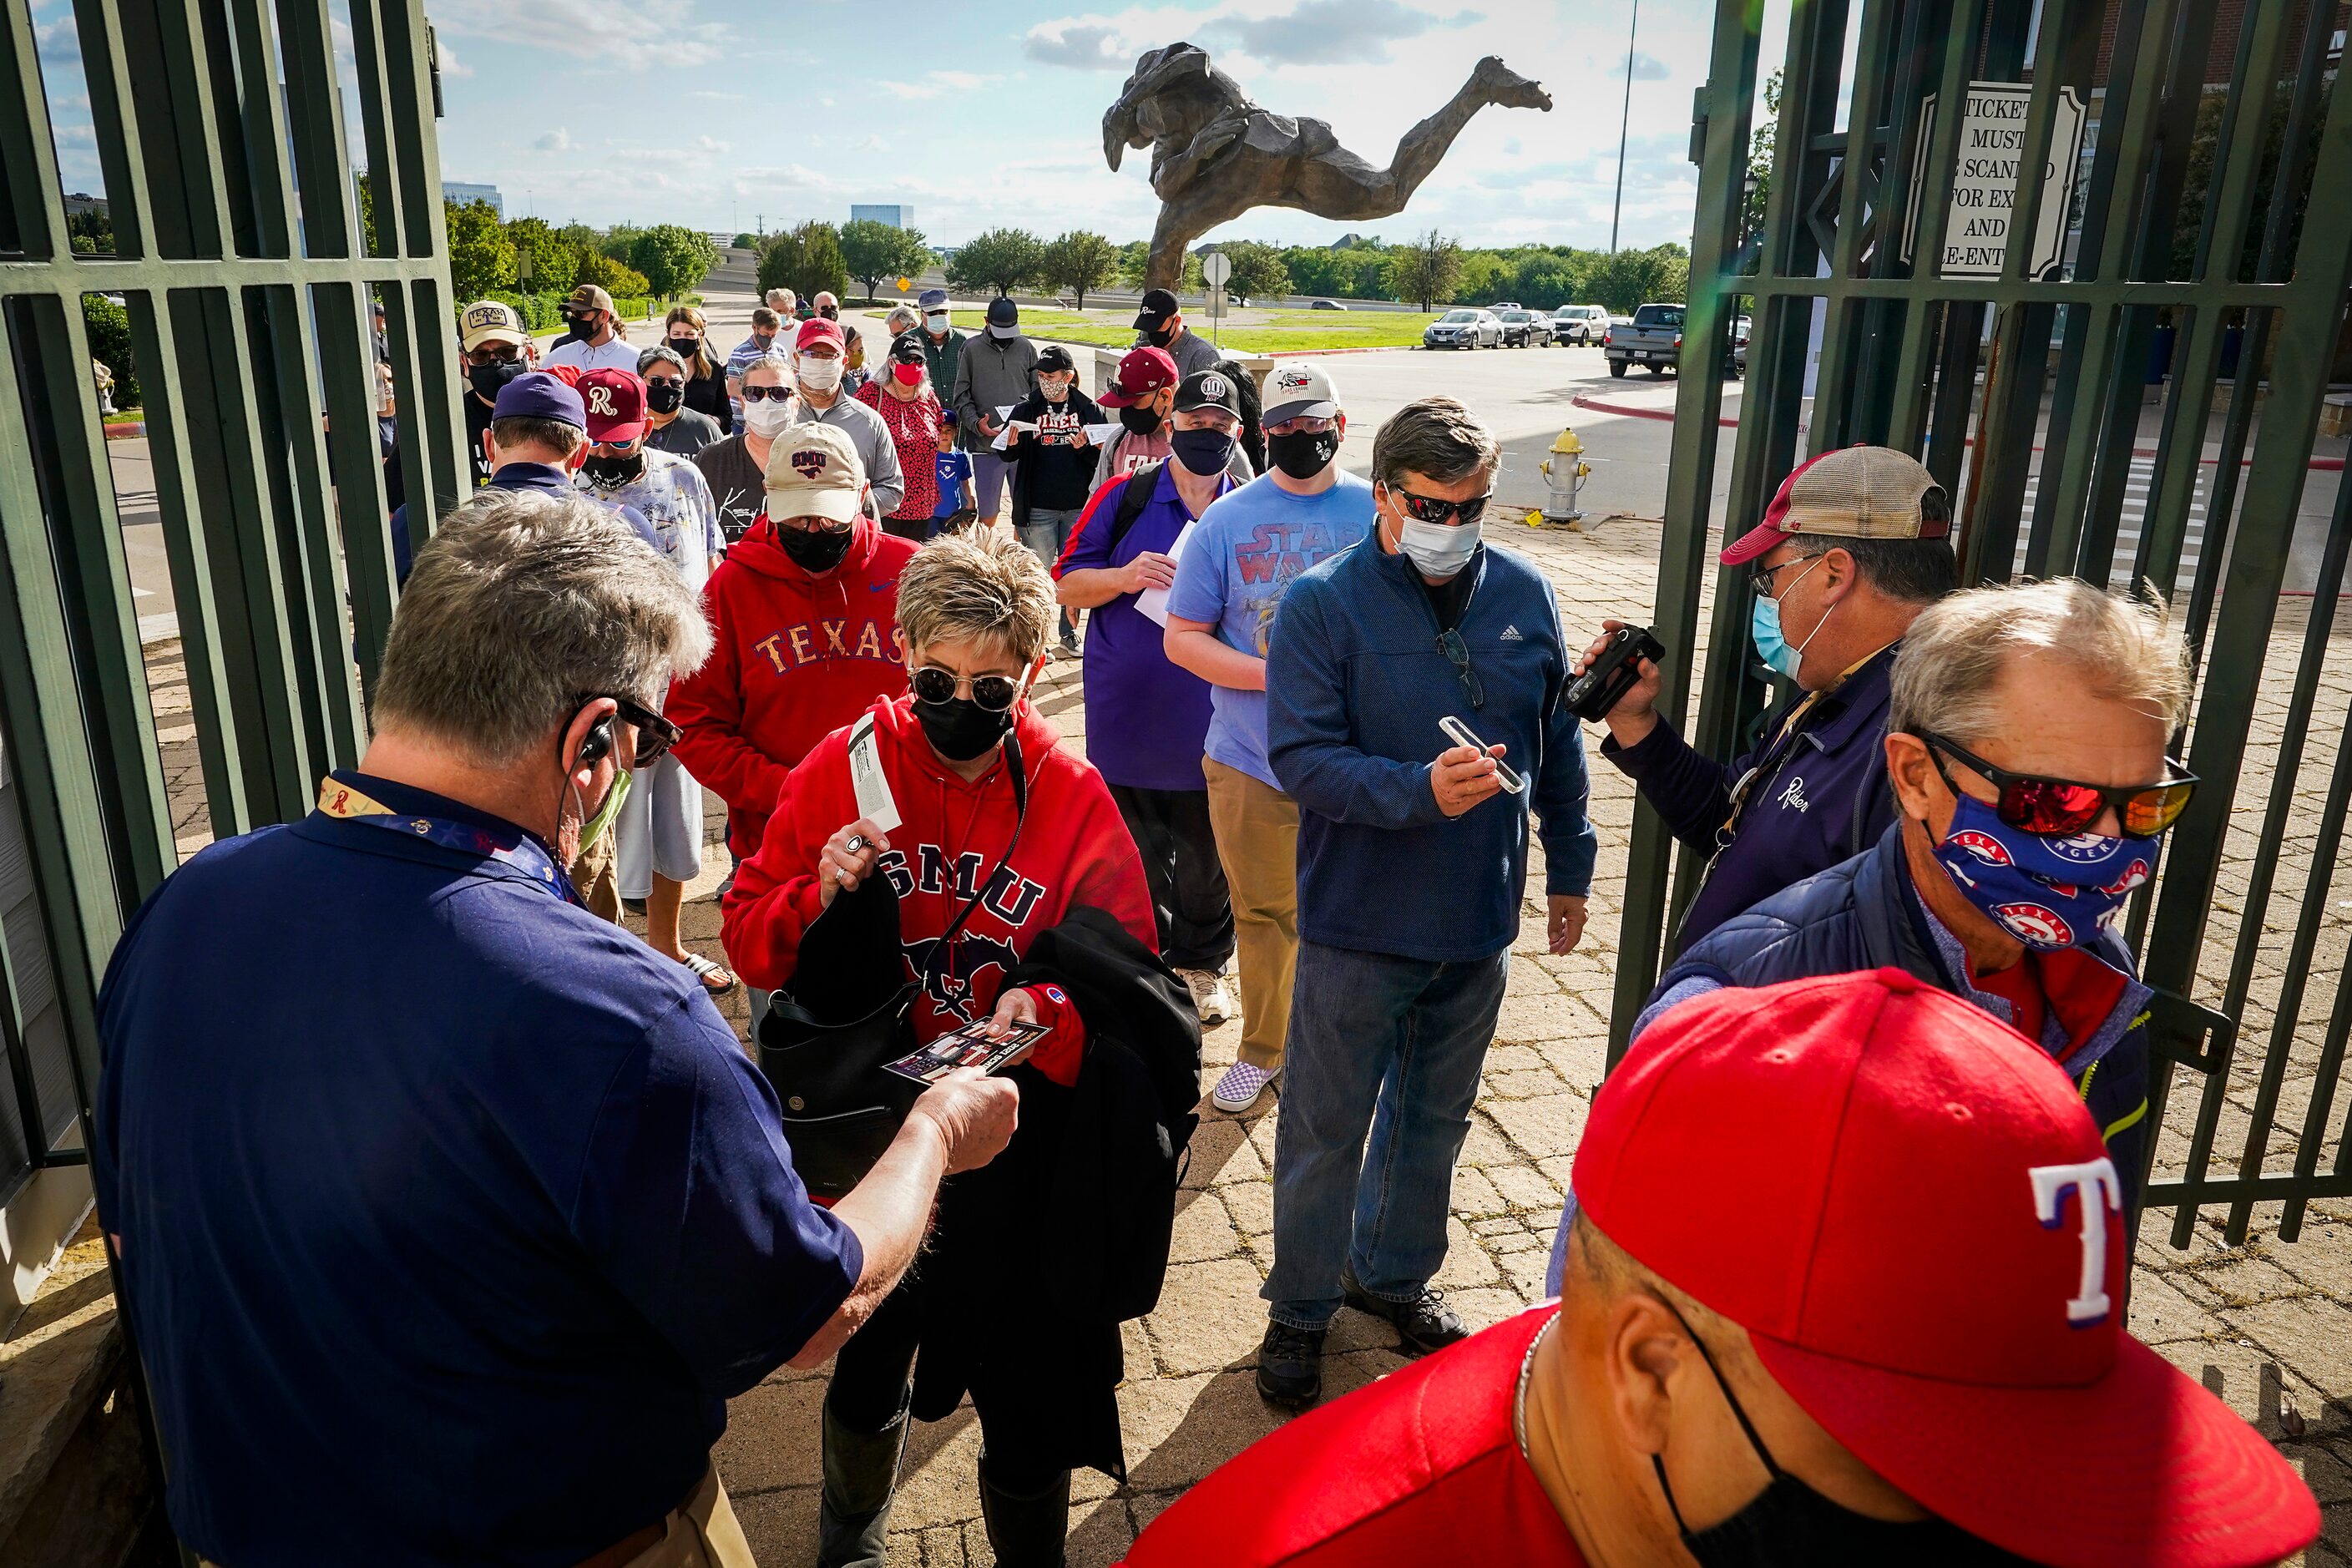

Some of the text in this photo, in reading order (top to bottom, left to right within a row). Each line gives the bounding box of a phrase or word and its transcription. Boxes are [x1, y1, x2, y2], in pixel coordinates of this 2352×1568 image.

[1964, 98, 2030, 119] TICKET
[1970, 129, 2026, 149] MUST
[1964, 159, 2056, 180] SCAND
[1988, 189, 2016, 209] EX
[1964, 218, 2006, 237] AND
[1943, 246, 2006, 266] E-ENT
[470, 307, 503, 319] TEXAS
[1206, 380, 1221, 393] 10
[792, 450, 827, 468] SMU
[604, 472, 623, 483] good
[1235, 523, 1364, 554] STAR
[751, 618, 905, 677] TEXAS
[877, 843, 1046, 928] SMU
[2006, 908, 2066, 935] TEXAS
[2028, 1156, 2122, 1329] T
